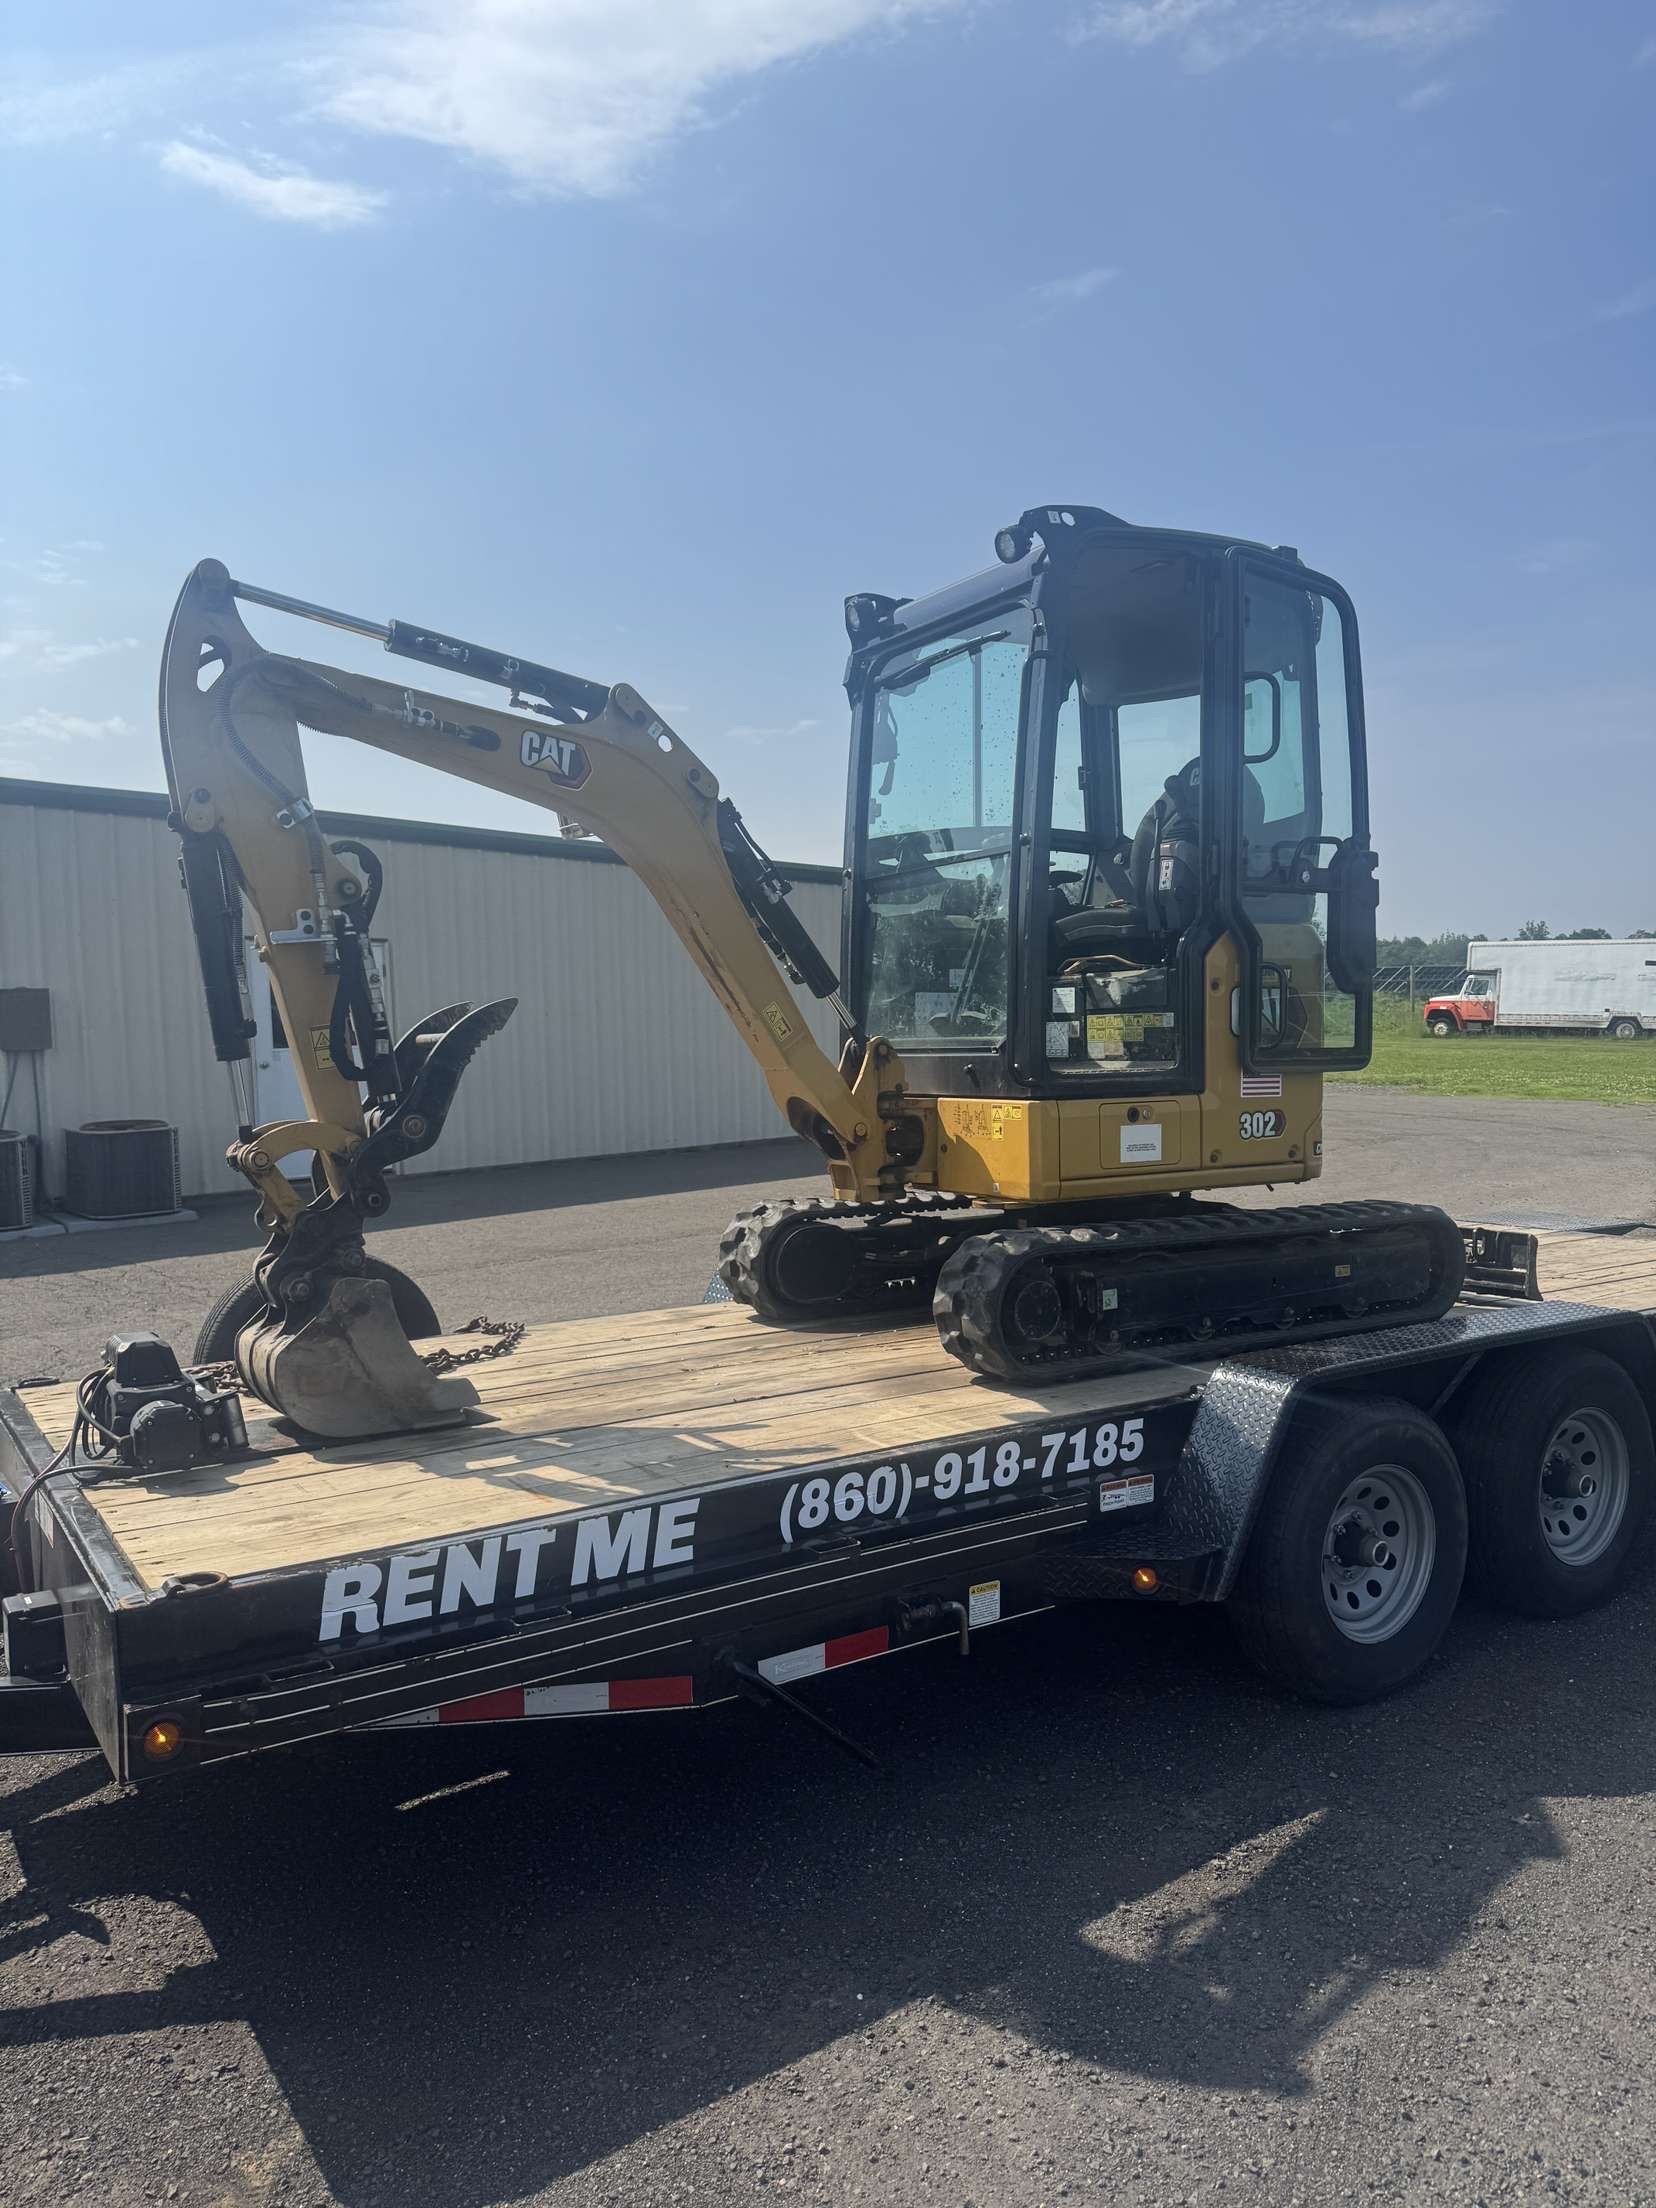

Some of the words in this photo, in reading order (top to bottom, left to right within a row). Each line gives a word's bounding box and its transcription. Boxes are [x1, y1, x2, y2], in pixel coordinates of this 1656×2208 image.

[521, 730, 576, 776] CAT
[1240, 1111, 1276, 1139] 302
[319, 1527, 557, 1642] RENT
[570, 1498, 701, 1587] ME
[780, 1418, 1145, 1544] (860)-918-7185
